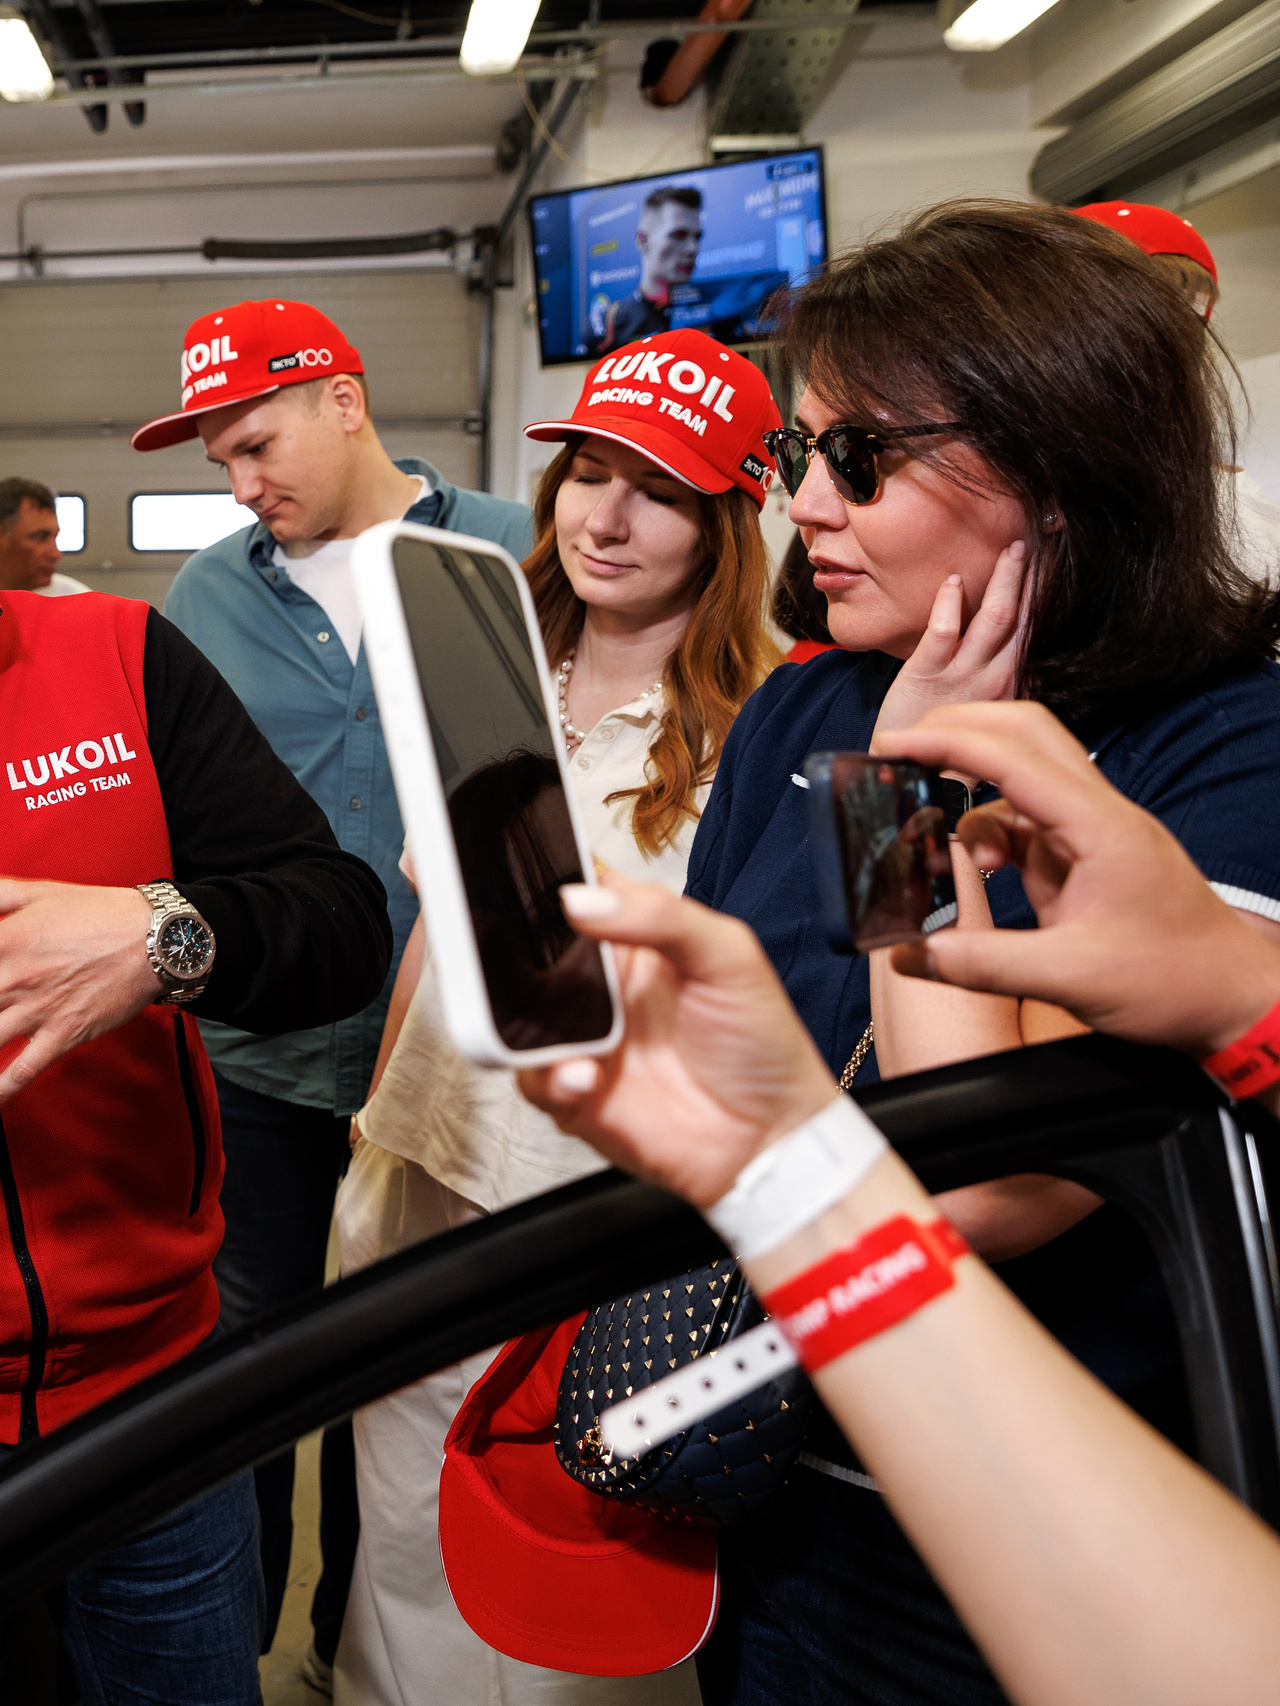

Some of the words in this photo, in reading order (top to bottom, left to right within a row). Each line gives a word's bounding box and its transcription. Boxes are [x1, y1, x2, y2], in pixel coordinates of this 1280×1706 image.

[193, 371, 227, 394] TEAM
[593, 351, 736, 423] LUKOIL
[588, 387, 654, 406] RACING
[658, 397, 708, 437] TEAM
[6, 732, 137, 791] LUKOIL
[25, 782, 86, 811] RACING
[89, 772, 131, 792] TEAM
